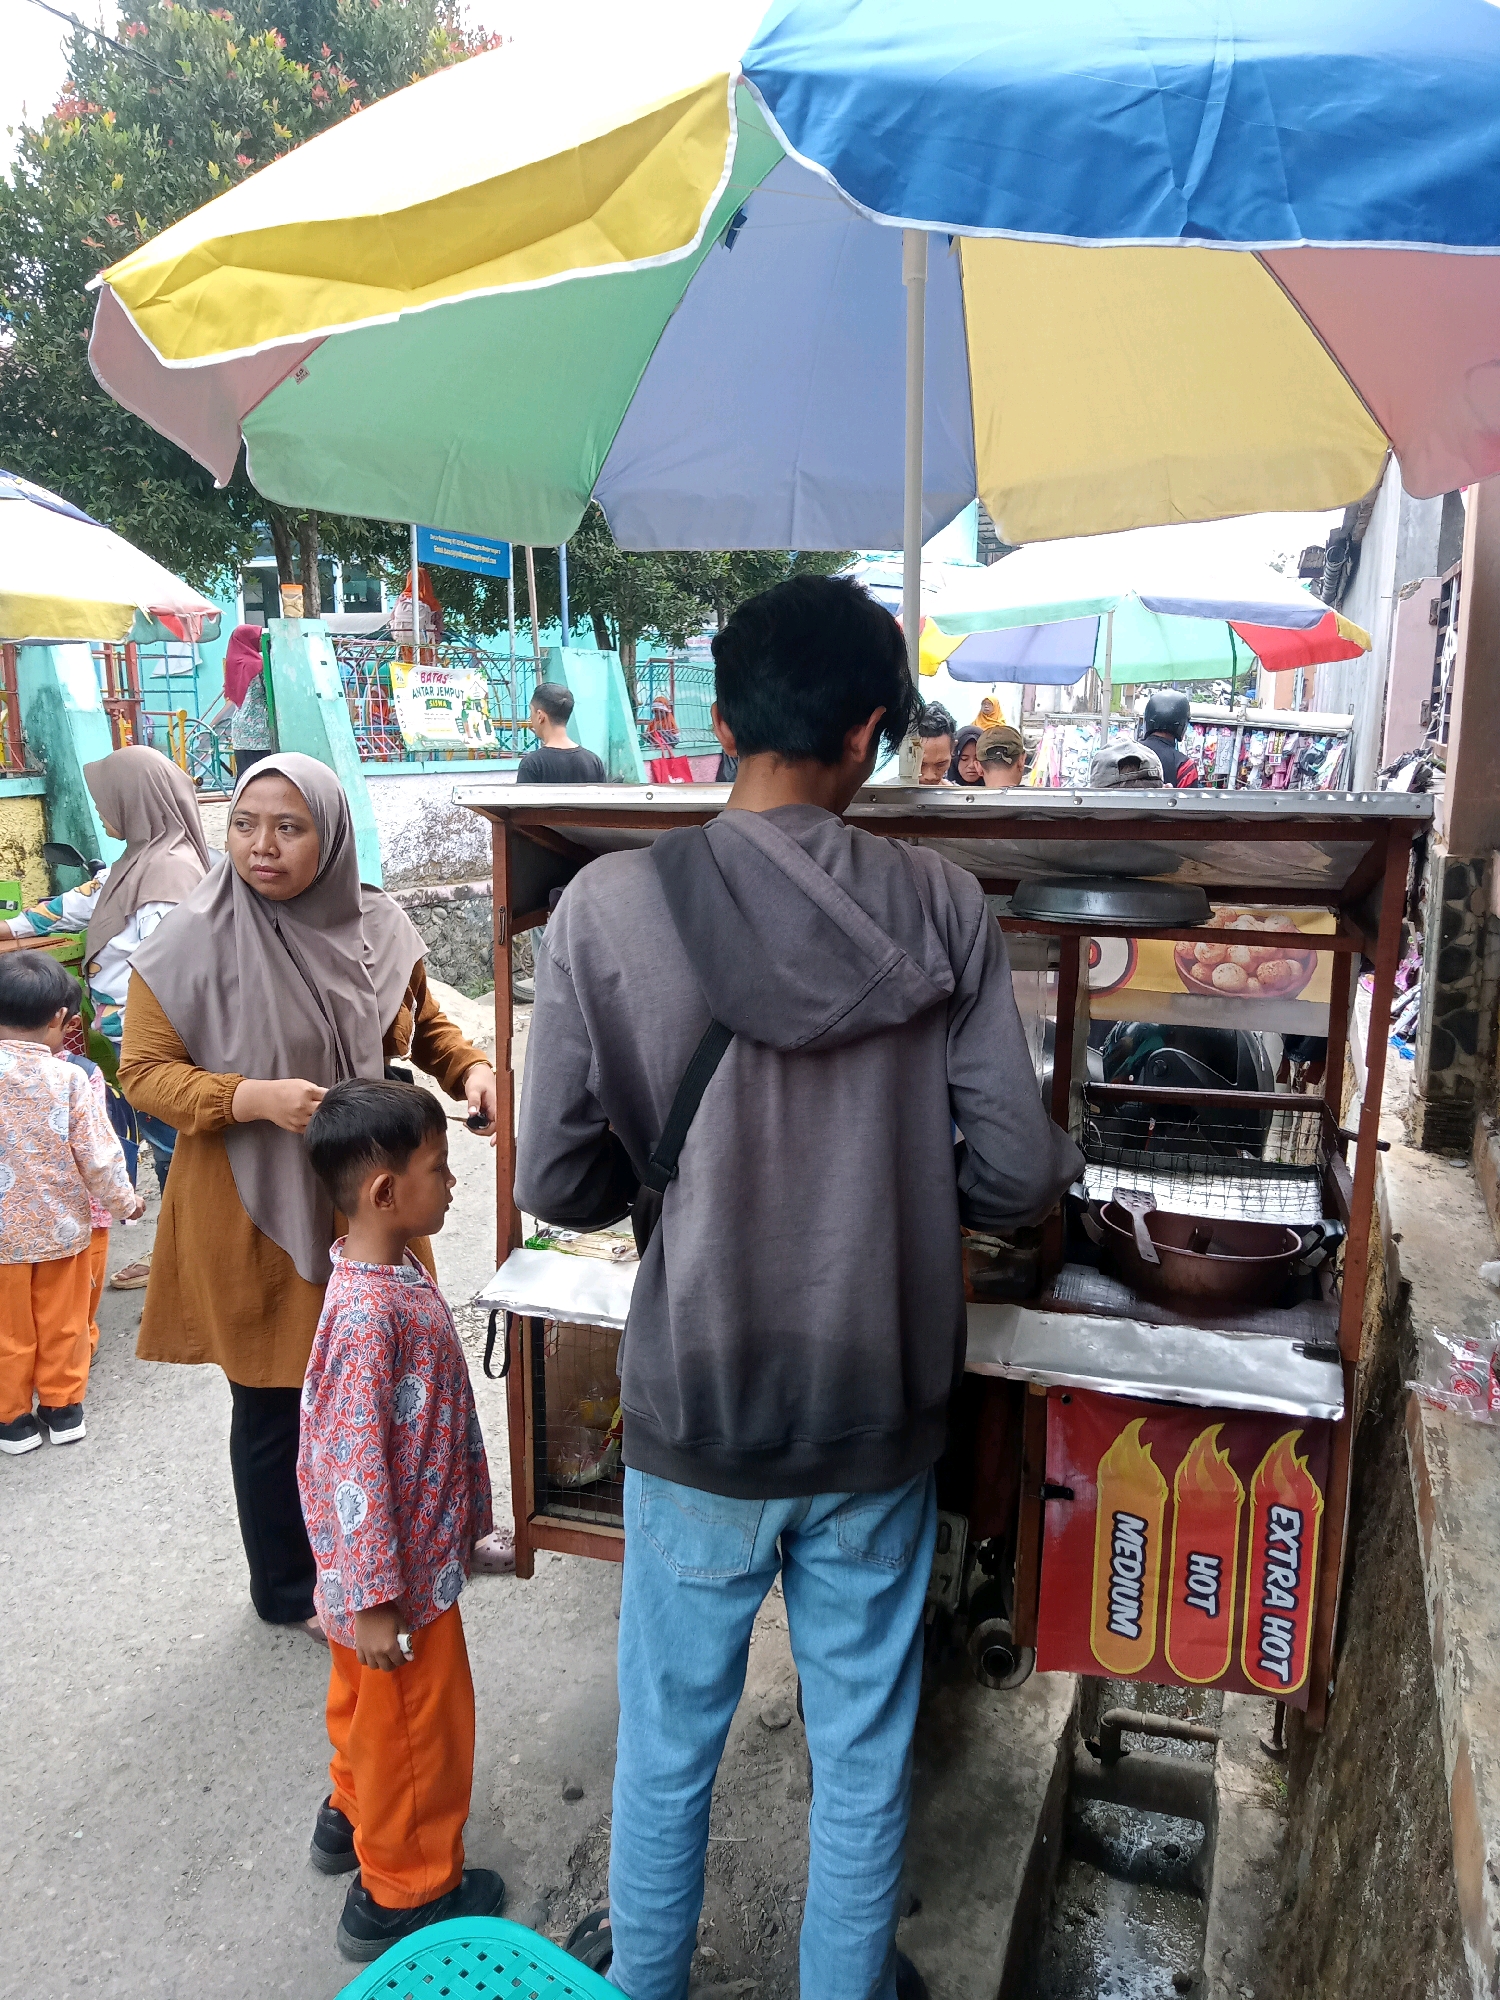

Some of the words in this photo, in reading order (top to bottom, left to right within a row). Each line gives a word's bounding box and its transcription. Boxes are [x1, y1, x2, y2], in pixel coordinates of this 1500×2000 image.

[412, 686, 434, 699] ANTAR
[437, 685, 464, 700] JEMPUT
[420, 671, 449, 684] BATAS
[429, 699, 447, 708] SISWA
[1109, 1511, 1146, 1639] MEDIUM
[1186, 1553, 1221, 1616] HOT
[1264, 1505, 1301, 1609] EXTRA
[1260, 1615, 1293, 1682] HOT
